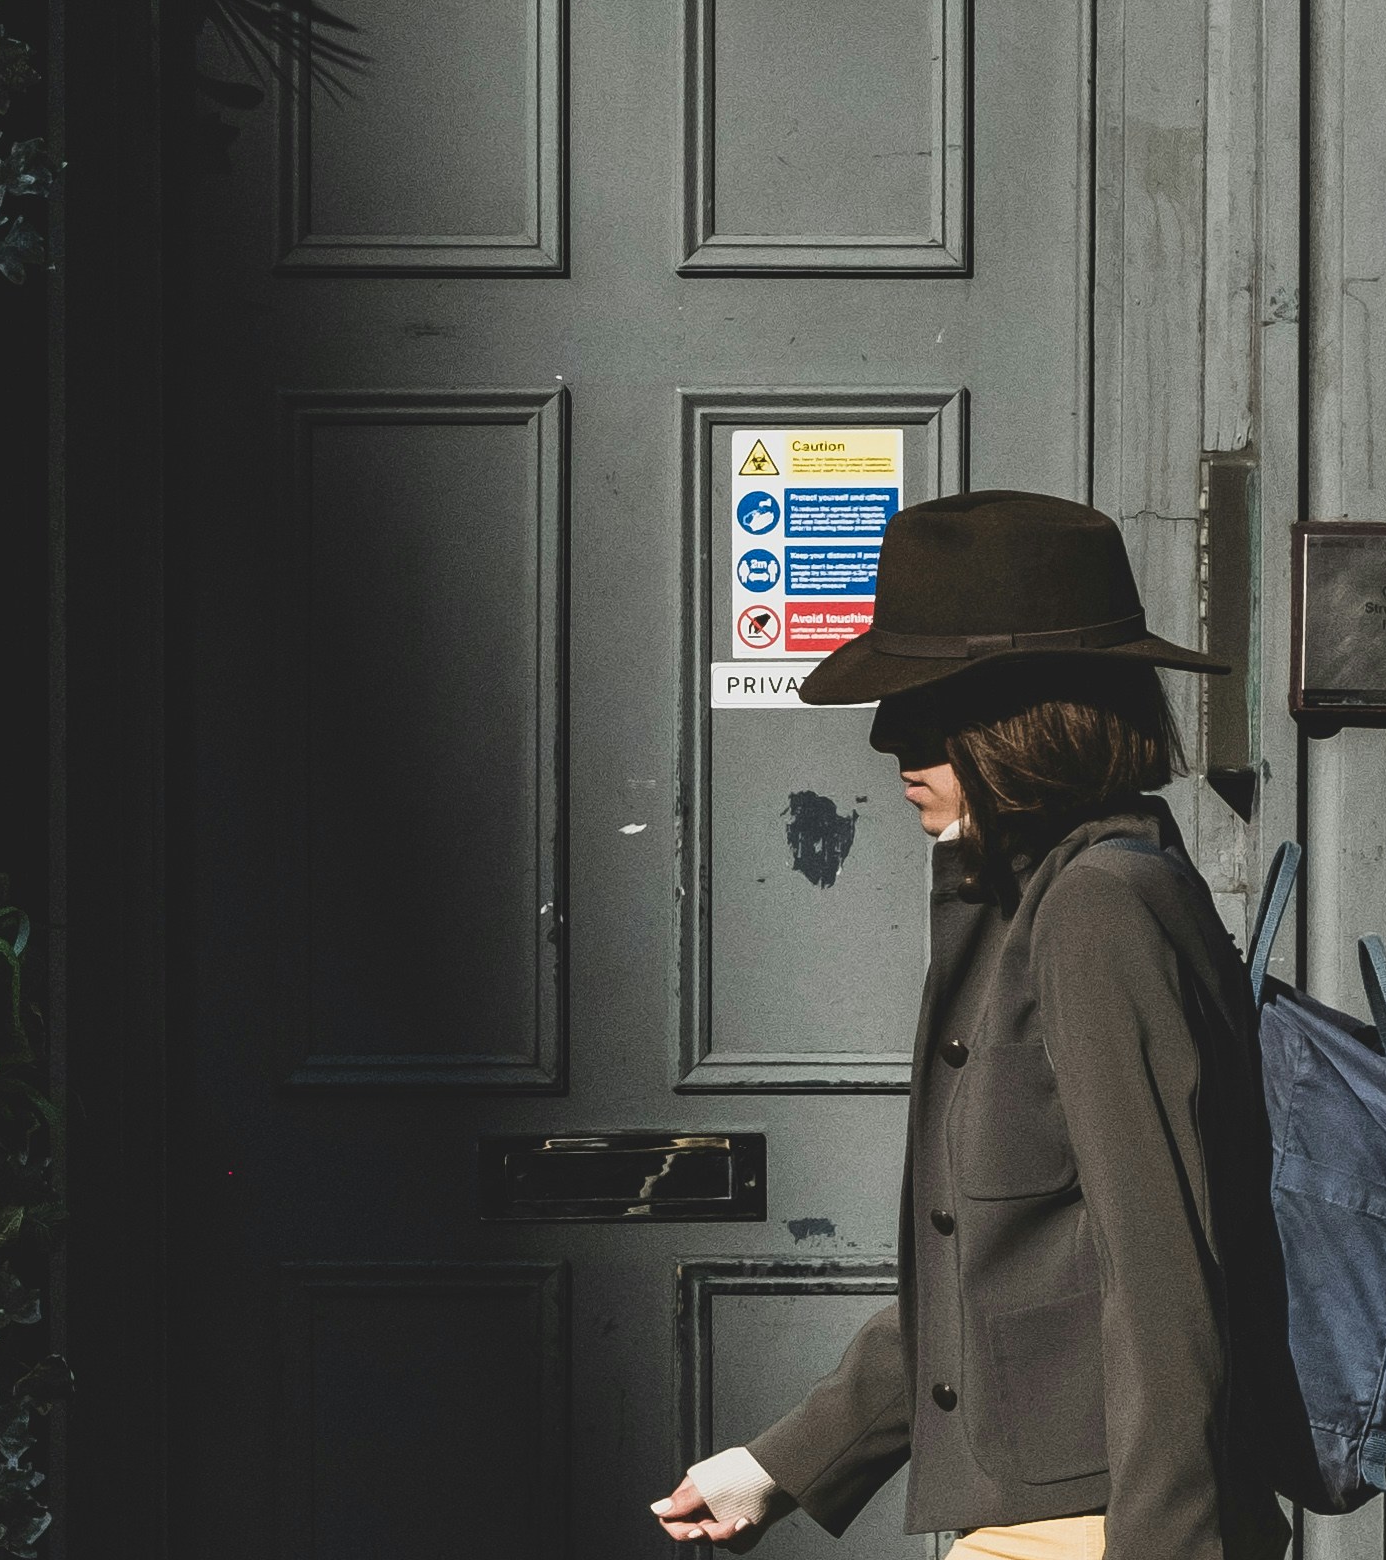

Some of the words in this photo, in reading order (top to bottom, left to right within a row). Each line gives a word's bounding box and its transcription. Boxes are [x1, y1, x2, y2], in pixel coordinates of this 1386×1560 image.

[792, 440, 845, 452] Caution
[790, 493, 817, 501] Protect
[790, 612, 824, 624] Avoid
[727, 676, 807, 694] PRIVA
